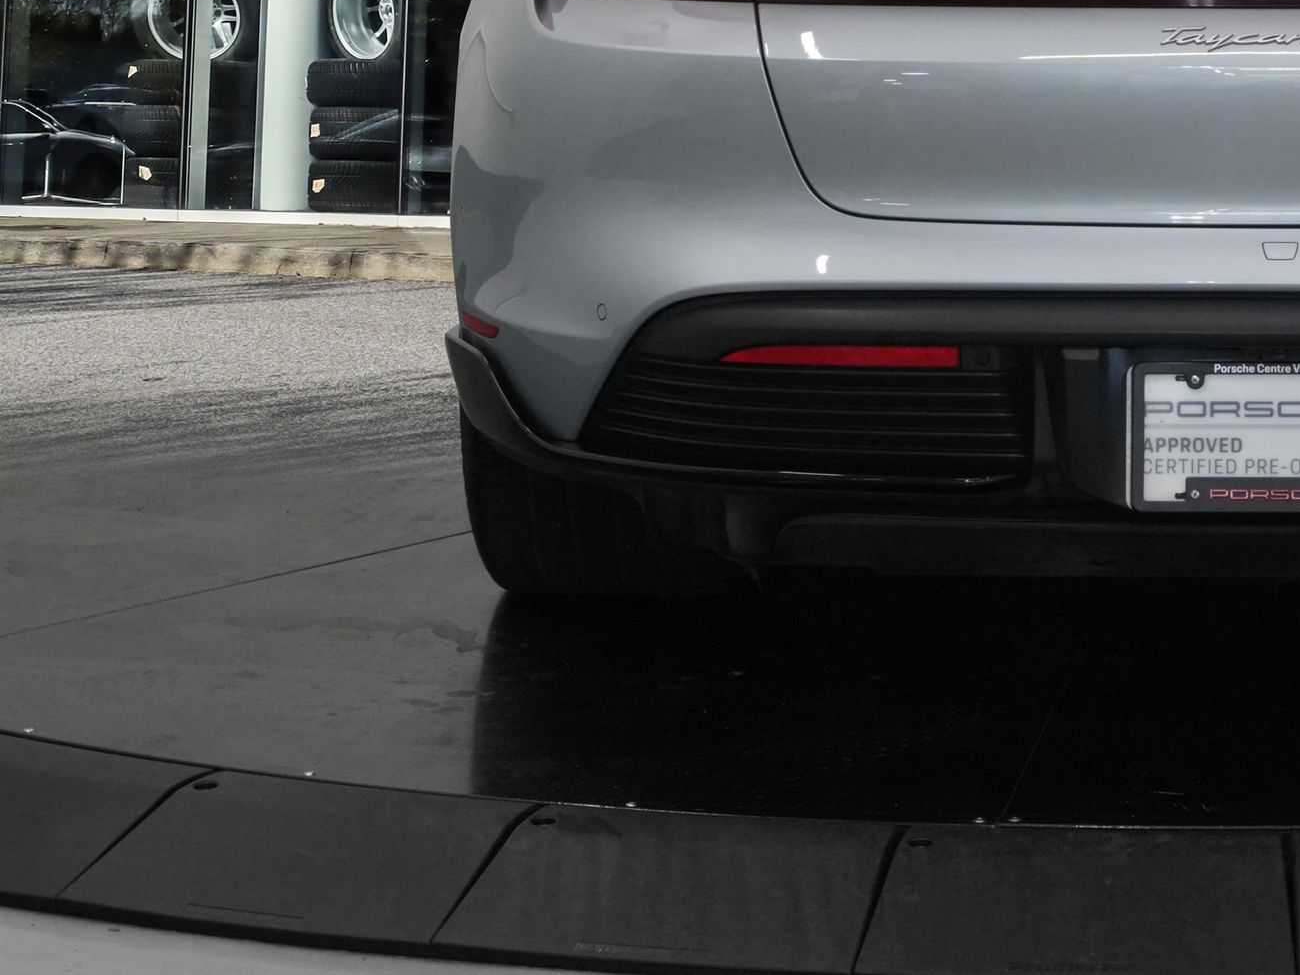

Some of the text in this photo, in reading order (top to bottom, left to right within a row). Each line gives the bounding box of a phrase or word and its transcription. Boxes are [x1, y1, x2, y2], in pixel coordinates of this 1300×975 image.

[1213, 363, 1255, 374] Porsche
[1256, 363, 1291, 374] Centre
[1144, 437, 1243, 453] APPROVED
[1144, 458, 1237, 475] CERTIFIED
